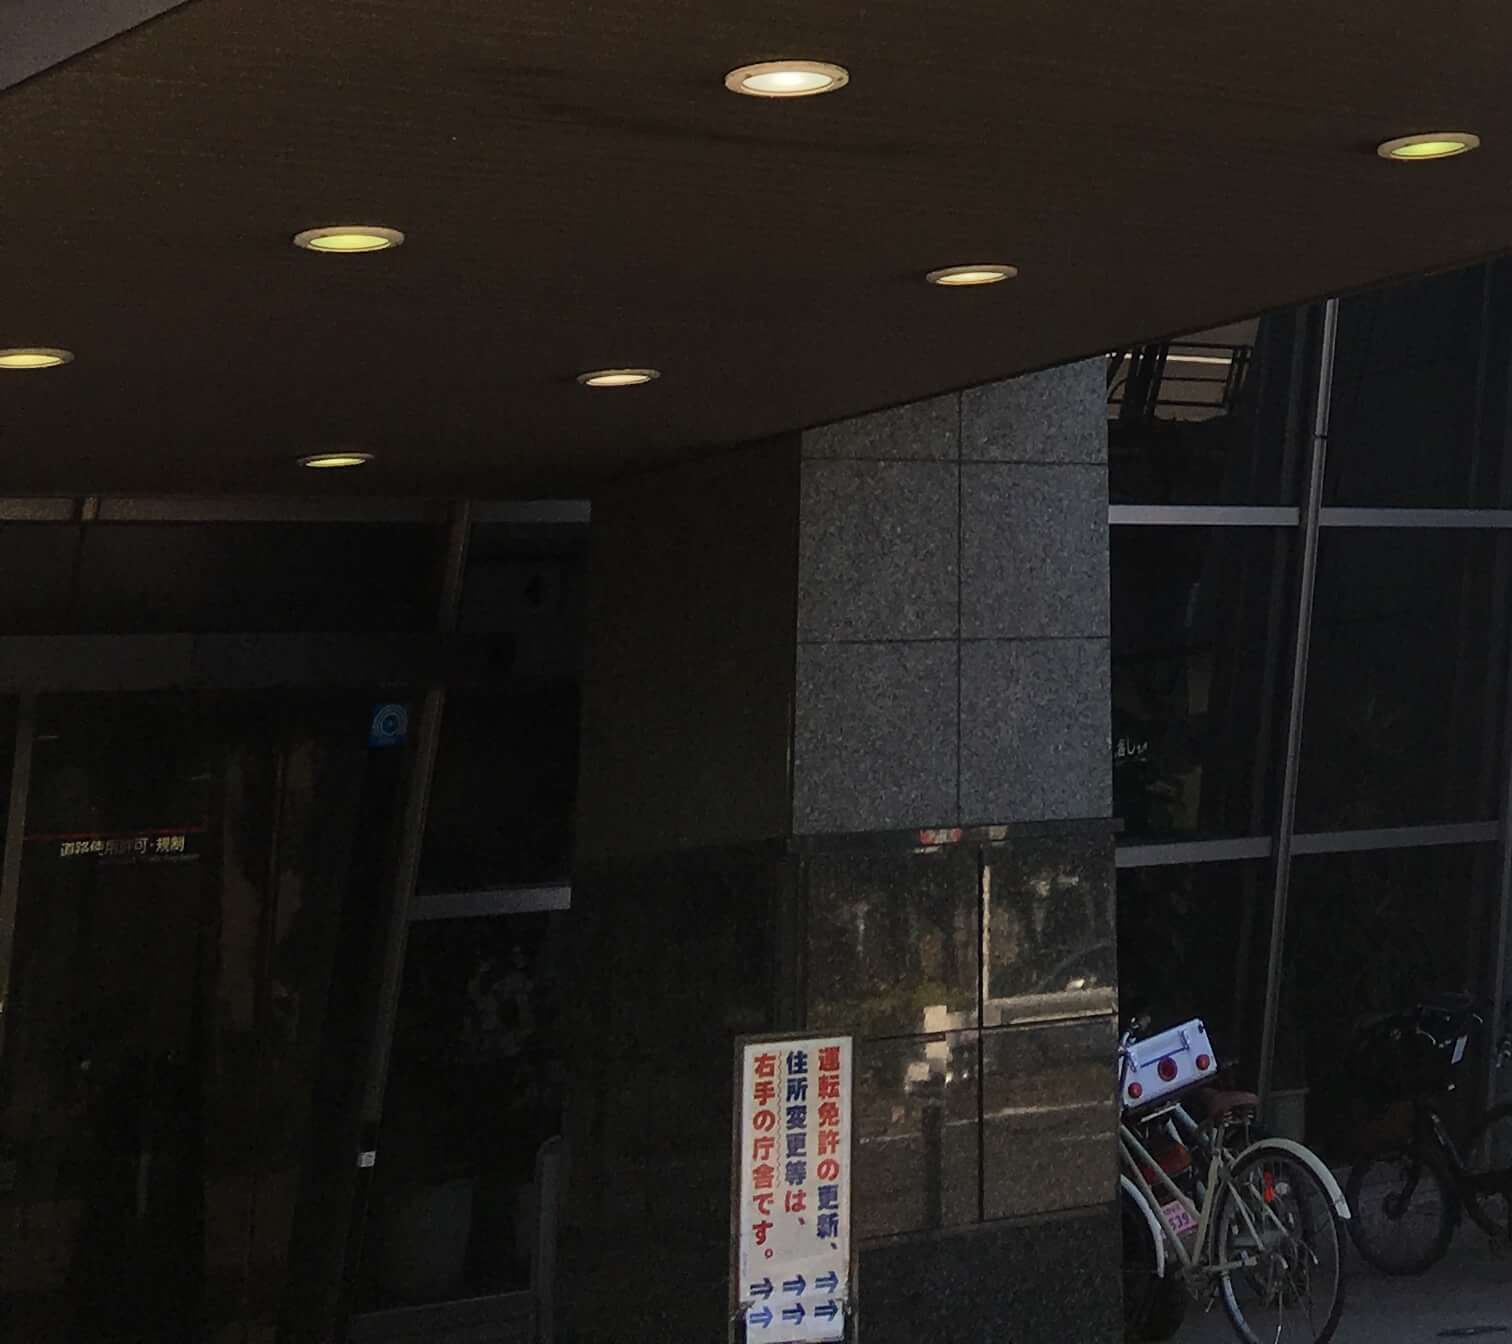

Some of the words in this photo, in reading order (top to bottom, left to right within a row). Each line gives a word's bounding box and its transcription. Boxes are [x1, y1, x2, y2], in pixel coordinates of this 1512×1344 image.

[752, 1053, 777, 1259] 右手の庁舎です。
[784, 1050, 808, 1226] 住所変更等は、
[816, 1046, 840, 1250] 運転免許の更新、
